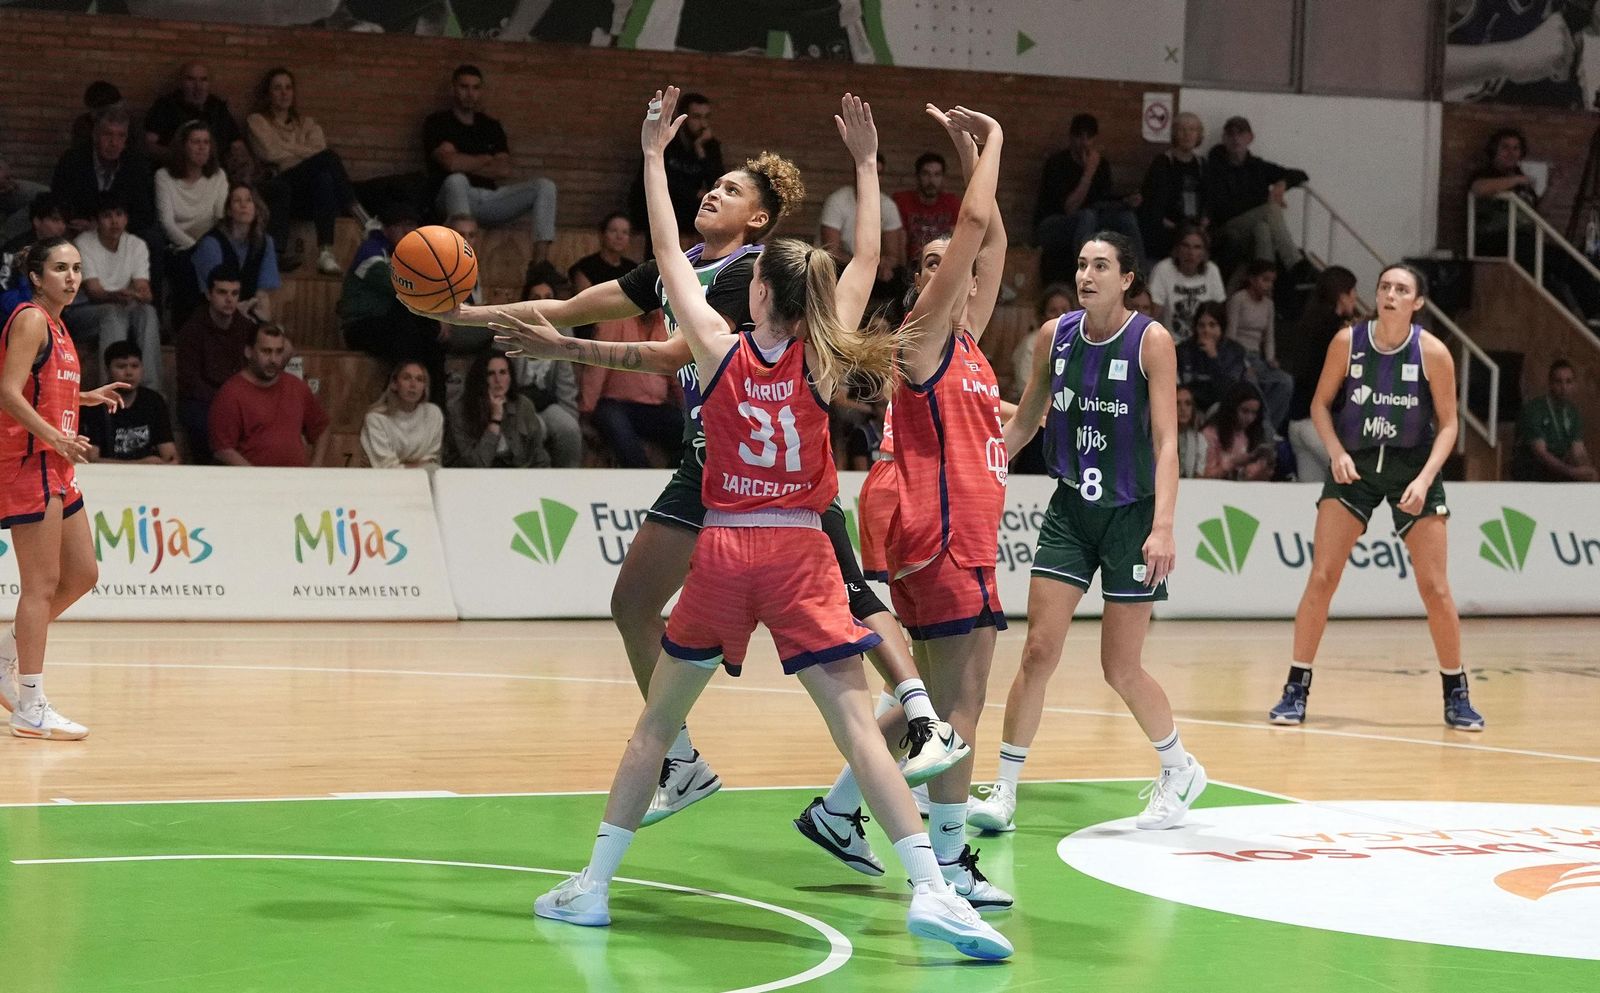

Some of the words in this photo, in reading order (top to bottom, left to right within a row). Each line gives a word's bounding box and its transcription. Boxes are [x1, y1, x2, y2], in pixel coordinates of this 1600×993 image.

[1078, 397, 1128, 418] Unicaja
[1372, 392, 1419, 409] Unicaja
[737, 400, 802, 473] 31
[1363, 416, 1397, 439] Mijas
[1080, 467, 1103, 501] 8
[590, 503, 648, 531] Fun
[1000, 503, 1046, 531] ció
[94, 505, 213, 574] Mijas
[294, 507, 408, 575] Mijas
[1550, 532, 1600, 565] Un
[0, 583, 19, 595] TO
[91, 584, 225, 596] AYUNTAMIENTO
[292, 585, 421, 597] AYUNTAMIENTO
[1171, 848, 1371, 862] SOL
[1366, 842, 1557, 856] DEL
